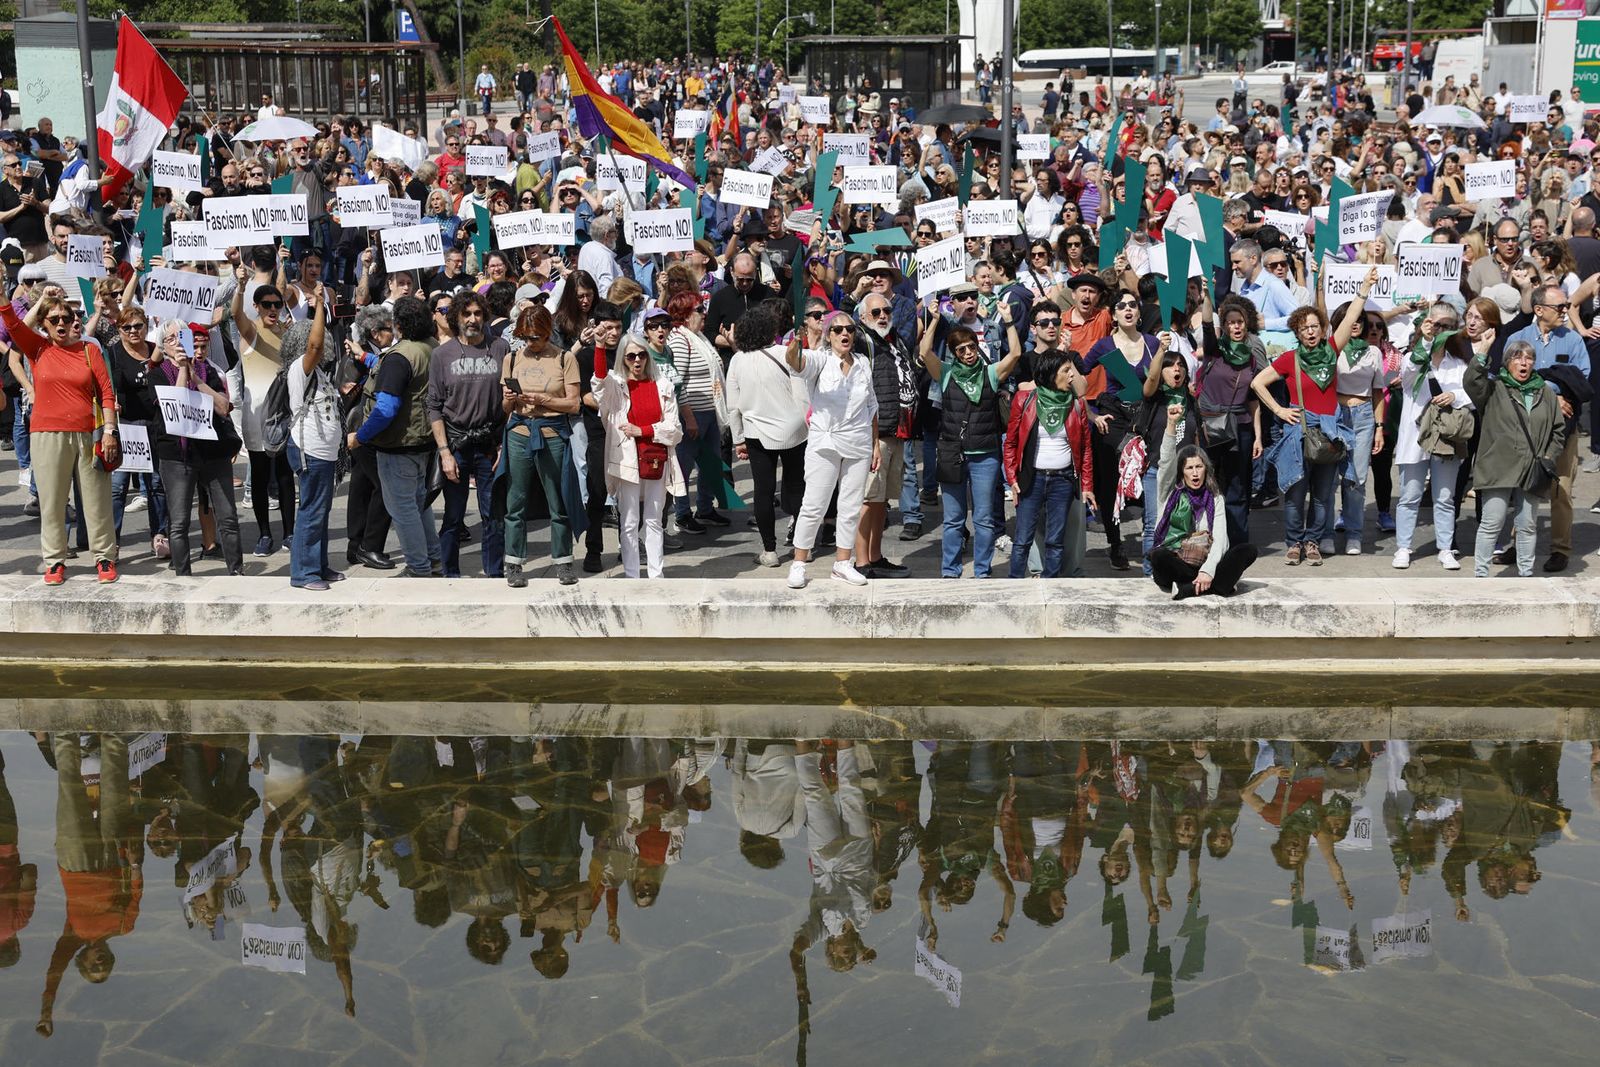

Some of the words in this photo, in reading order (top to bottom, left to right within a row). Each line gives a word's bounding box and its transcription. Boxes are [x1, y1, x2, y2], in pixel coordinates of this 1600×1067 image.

[401, 12, 413, 32] P
[856, 142, 868, 155] NO!
[154, 159, 186, 177] Fascismo,
[188, 164, 199, 178] NO!
[467, 153, 493, 165] Fascismo,
[496, 154, 506, 166] NO!
[632, 165, 645, 179] NO!
[1466, 173, 1499, 187] Fascismo,
[1501, 170, 1513, 184] NO!
[724, 176, 756, 195] Fascismo,
[757, 182, 770, 196] NO!
[845, 176, 879, 190] Fascismo,
[882, 175, 894, 190] NO!
[291, 205, 306, 220] NO!
[338, 196, 374, 214] Fascismo,
[375, 194, 390, 210] NO!
[205, 211, 250, 230] Fascismo,
[252, 208, 269, 227] NO!
[967, 209, 1000, 225] Fascismo,
[1003, 209, 1015, 222] NO!
[1342, 212, 1359, 223] Diga
[1360, 209, 1369, 219] lo
[496, 221, 530, 238] Fascismo,
[530, 216, 544, 232] NO!
[562, 221, 573, 234] NO!
[633, 221, 674, 241] Fascismo,
[676, 219, 692, 236] NO!
[1342, 225, 1356, 235] es
[383, 239, 424, 257] Fascismo,
[424, 234, 440, 251] NO!
[918, 257, 949, 281] Fascismo,
[950, 247, 963, 269] NO!
[1400, 256, 1441, 278] Fascismo,
[1445, 257, 1460, 276] NO!
[150, 280, 194, 306] Fascismo,
[196, 288, 214, 308] NO!
[1328, 274, 1372, 298] Fascism,
[1374, 276, 1392, 296] NO!
[161, 402, 179, 423] NO!
[180, 403, 212, 430] Fascismo,
